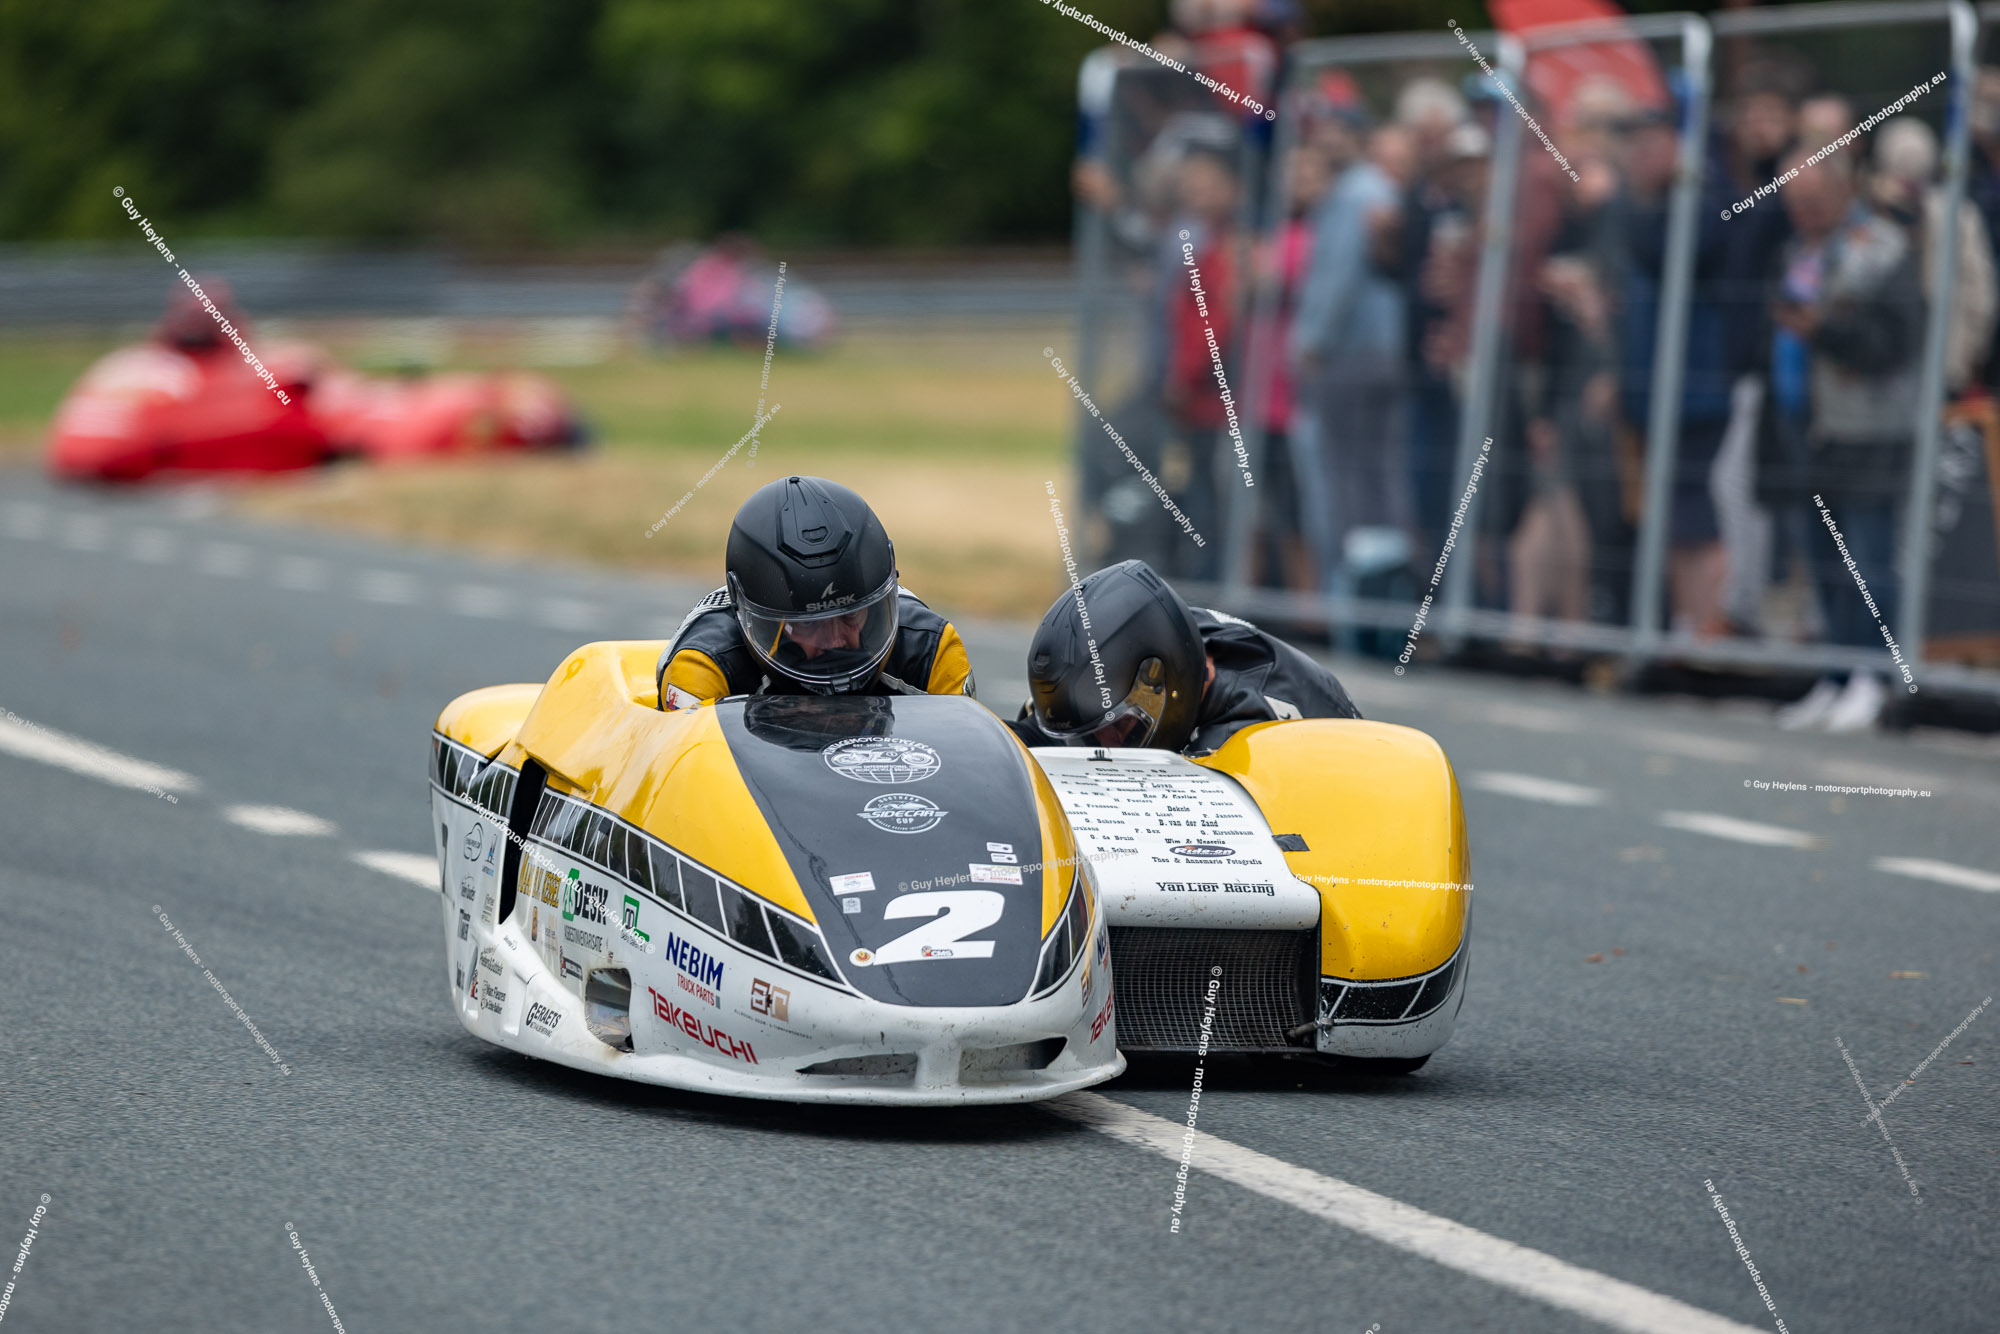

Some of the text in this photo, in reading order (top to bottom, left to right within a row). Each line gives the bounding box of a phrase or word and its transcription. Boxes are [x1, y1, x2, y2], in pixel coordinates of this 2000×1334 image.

[806, 593, 857, 612] SHARK
[871, 810, 936, 818] SIDECAR
[1200, 819, 1219, 827] Zand
[1155, 882, 1276, 897] Van Lier Racing
[873, 890, 1005, 965] 2
[666, 931, 724, 991] NEBIM
[677, 972, 715, 1007] TRUCK PARTS
[526, 1001, 562, 1028] GERAETS
